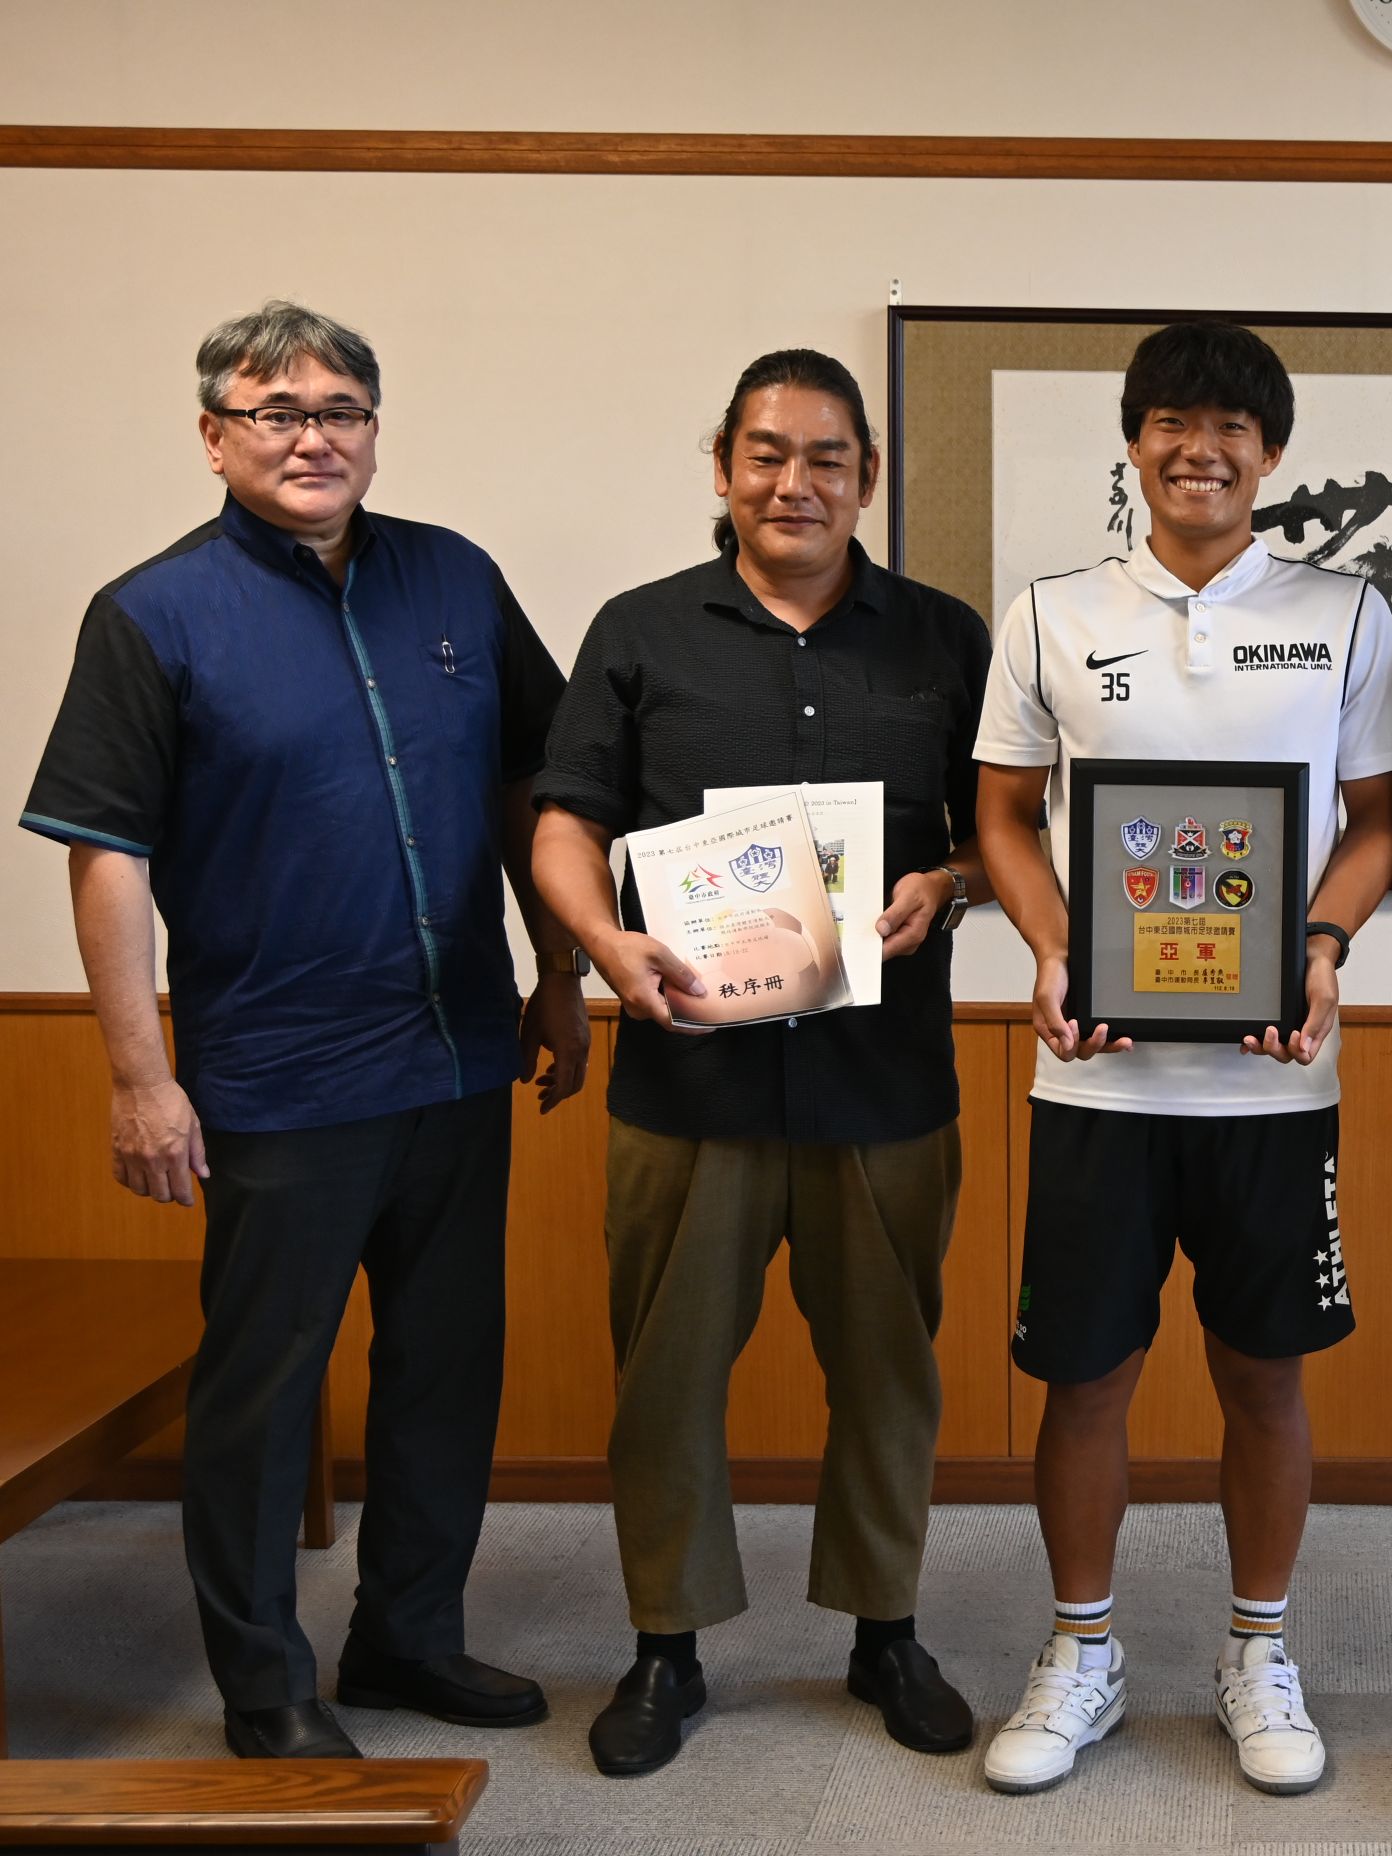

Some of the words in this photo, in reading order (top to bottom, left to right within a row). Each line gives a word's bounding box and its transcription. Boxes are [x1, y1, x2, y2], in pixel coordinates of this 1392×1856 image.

[1233, 643, 1332, 664] OKINAWA
[1234, 662, 1308, 672] INTERNATIONAL
[1310, 663, 1333, 671] UNIV.
[1101, 673, 1130, 701] 35
[637, 850, 656, 859] 2023
[718, 975, 784, 999] 秩序冊
